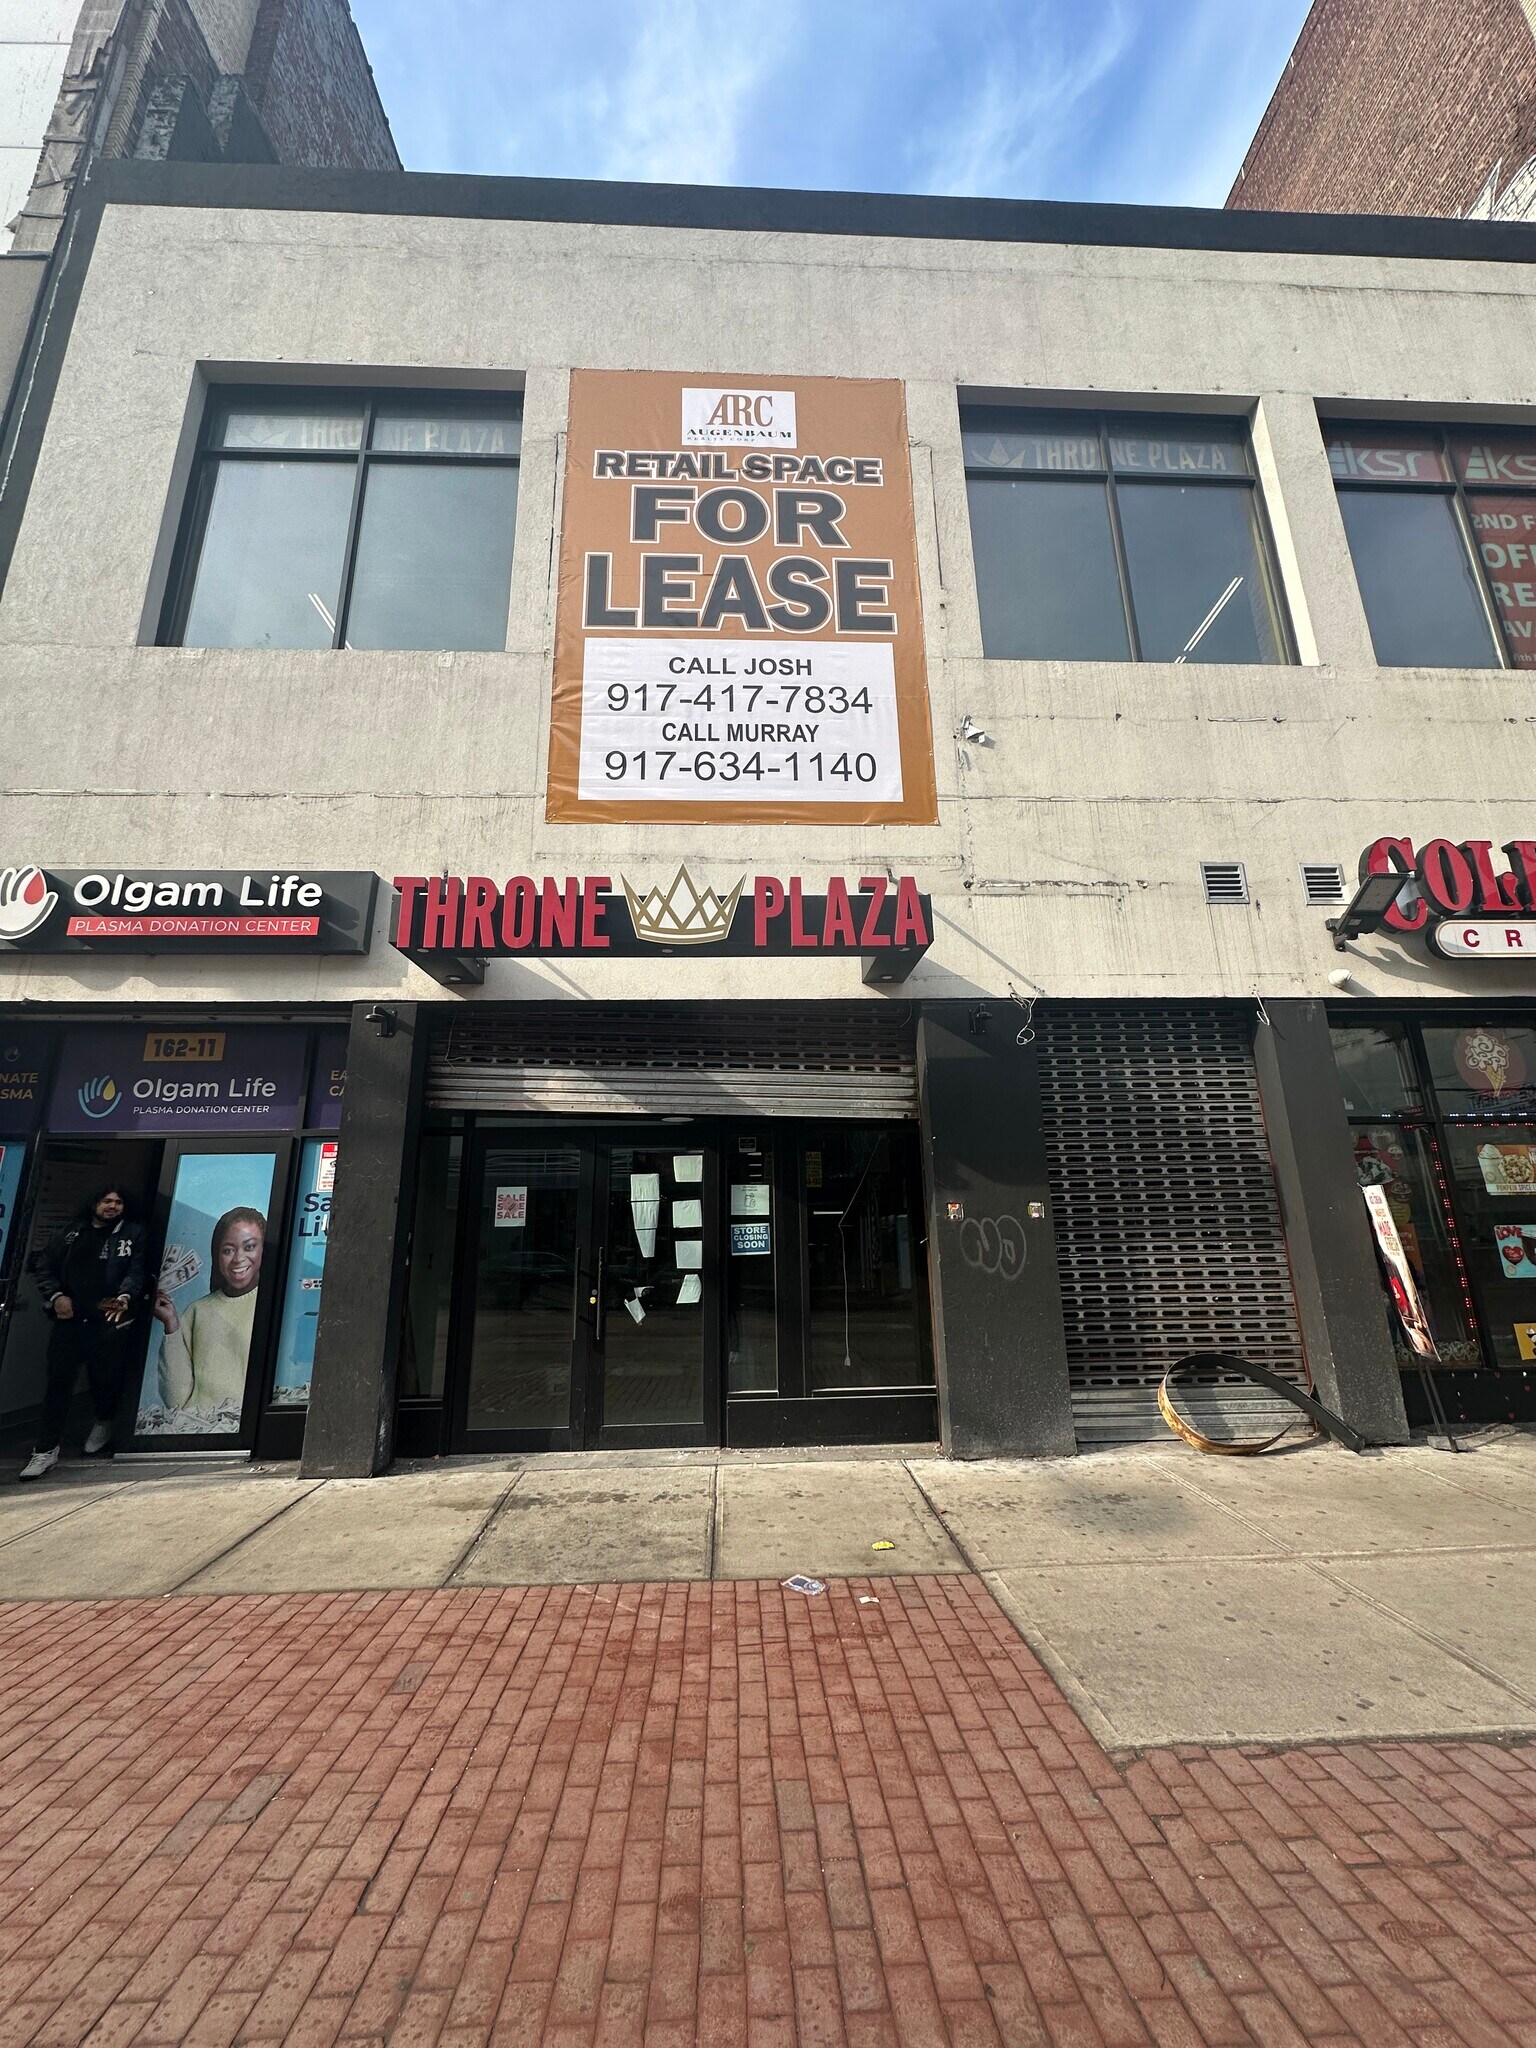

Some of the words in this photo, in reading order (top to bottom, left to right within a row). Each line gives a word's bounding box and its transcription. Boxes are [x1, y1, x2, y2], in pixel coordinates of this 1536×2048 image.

[706, 394, 773, 427] ARC
[687, 428, 792, 438] AUGENBAUM
[1149, 442, 1228, 471] PLAZA
[593, 450, 739, 482] RETAIL
[742, 453, 884, 486] SPACE
[630, 484, 852, 548] FOR
[582, 552, 898, 634] LEASE
[668, 656, 736, 675] CALL
[743, 658, 813, 676] JOSH
[606, 683, 873, 714] 917-417-7834
[661, 722, 720, 742] CALL
[727, 724, 820, 743] MURRAY
[604, 750, 878, 782] 917-634-1140
[74, 873, 224, 913] Olgam
[239, 875, 323, 908] Life
[393, 876, 613, 949] THRONE
[754, 876, 930, 948] PLAZA
[74, 920, 144, 933] PLASMA
[149, 920, 241, 933] DONATION
[245, 920, 312, 933] CENTER
[153, 1038, 217, 1058] 162-11
[132, 1078, 220, 1102] Olgam
[228, 1077, 277, 1099] Life
[133, 1105, 174, 1115] PLASMA
[175, 1105, 228, 1114] DONATION
[231, 1105, 270, 1114] CENTER
[497, 1193, 526, 1202] SALE
[496, 1210, 525, 1220] SALE
[733, 1226, 767, 1235] STORE
[733, 1233, 769, 1241] CLOSING
[737, 1240, 766, 1249] SOON
